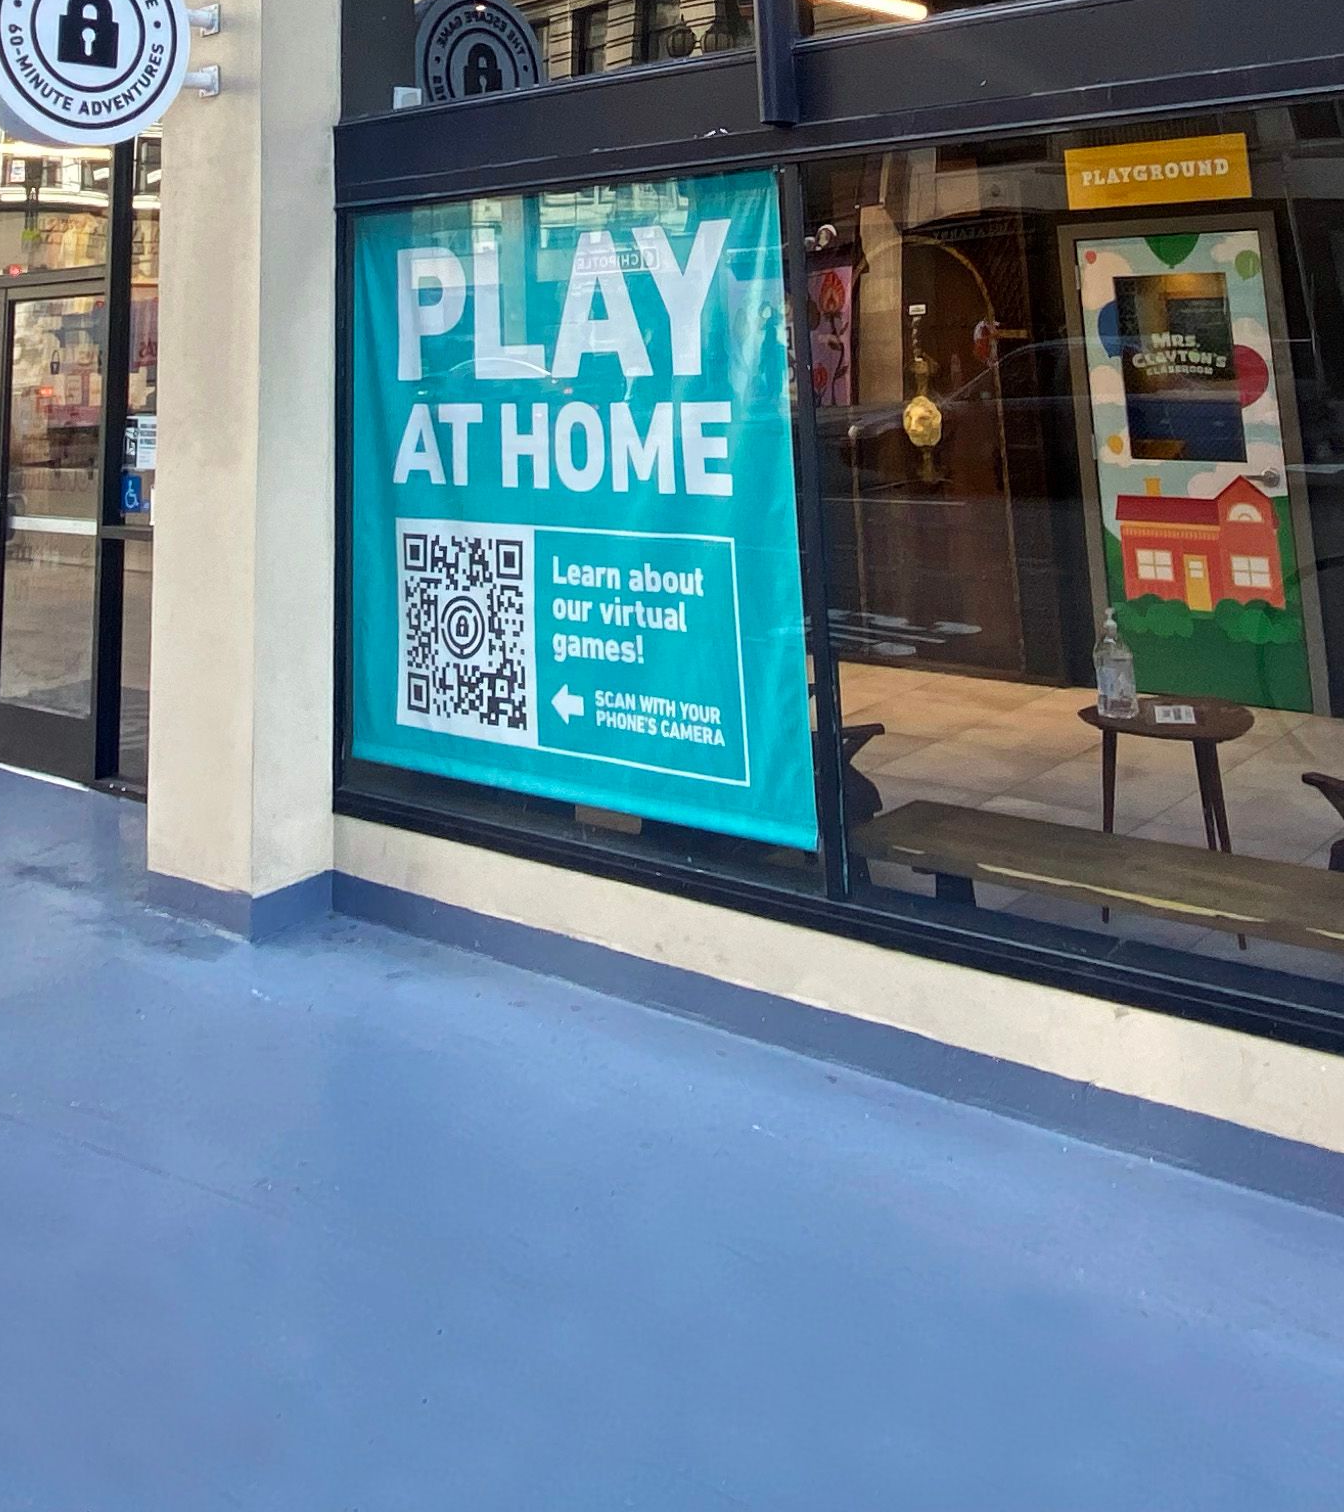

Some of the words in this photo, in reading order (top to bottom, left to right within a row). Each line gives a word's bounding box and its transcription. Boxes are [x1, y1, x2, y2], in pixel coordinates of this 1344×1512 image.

[8, 23, 74, 111] 60-MINUTE
[78, 43, 164, 116] ADVENTURES
[1081, 158, 1230, 186] PLAYGROUND
[397, 219, 732, 382] PLAY
[1132, 349, 1228, 368] CLAYTON'S
[393, 403, 483, 486] AT
[501, 400, 733, 497] HOME
[552, 555, 621, 590] Learn
[629, 562, 704, 597] about
[552, 597, 593, 622] our
[599, 596, 687, 633] virtual
[552, 633, 645, 664] games!
[594, 689, 636, 711] SCAN
[639, 694, 676, 718] WITH
[679, 701, 722, 725] YOUR
[596, 710, 657, 736] PHONE'S
[660, 719, 726, 747] CAMERA
